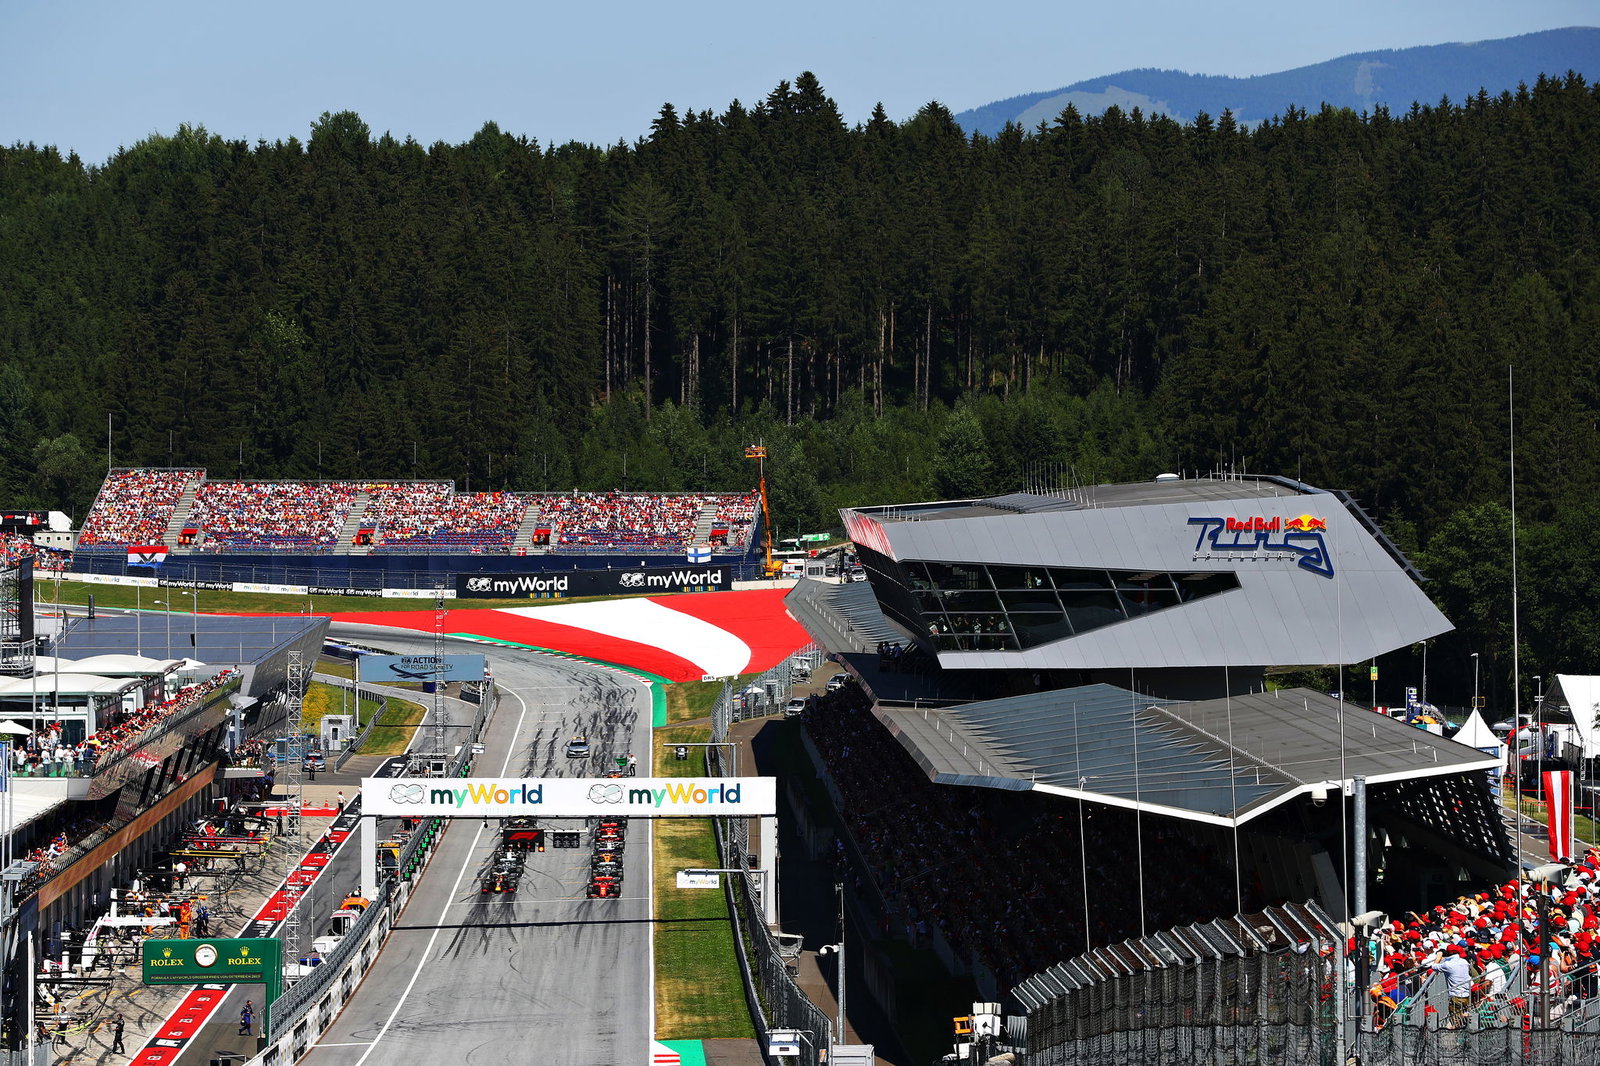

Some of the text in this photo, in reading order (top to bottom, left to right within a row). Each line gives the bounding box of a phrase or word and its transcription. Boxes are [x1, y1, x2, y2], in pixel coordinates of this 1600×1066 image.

[1226, 516, 1280, 531] Red Bull
[1187, 517, 1334, 579] Ring
[205, 582, 233, 590] myWorld
[494, 576, 568, 594] myWorld
[647, 570, 722, 588] myWorld
[430, 783, 543, 808] myWorld
[629, 783, 741, 808] myWorld
